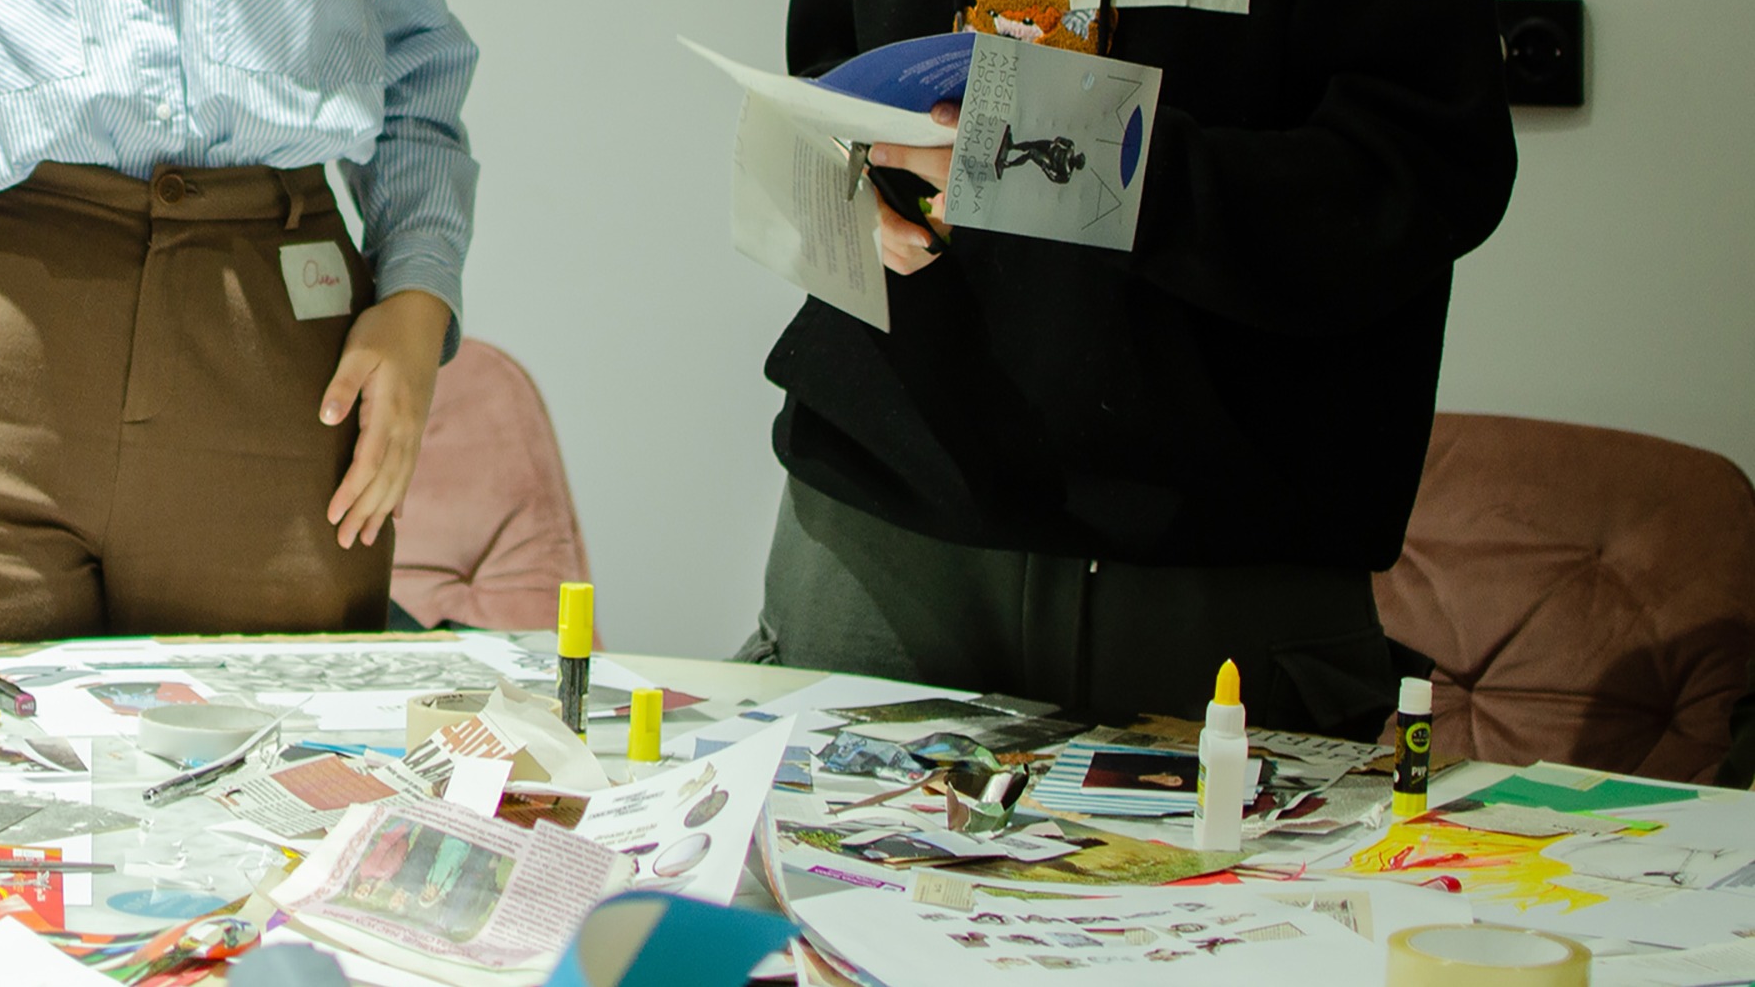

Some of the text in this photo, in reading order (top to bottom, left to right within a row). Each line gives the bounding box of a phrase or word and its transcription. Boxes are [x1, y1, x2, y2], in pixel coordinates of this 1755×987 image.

[949, 50, 988, 212] APOXYOMENOS
[966, 51, 998, 174] MUSEUM OF
[971, 55, 1009, 214] APOKSIOMENA
[1000, 56, 1020, 124] MUZEJ
[1411, 766, 1427, 778] PVP
